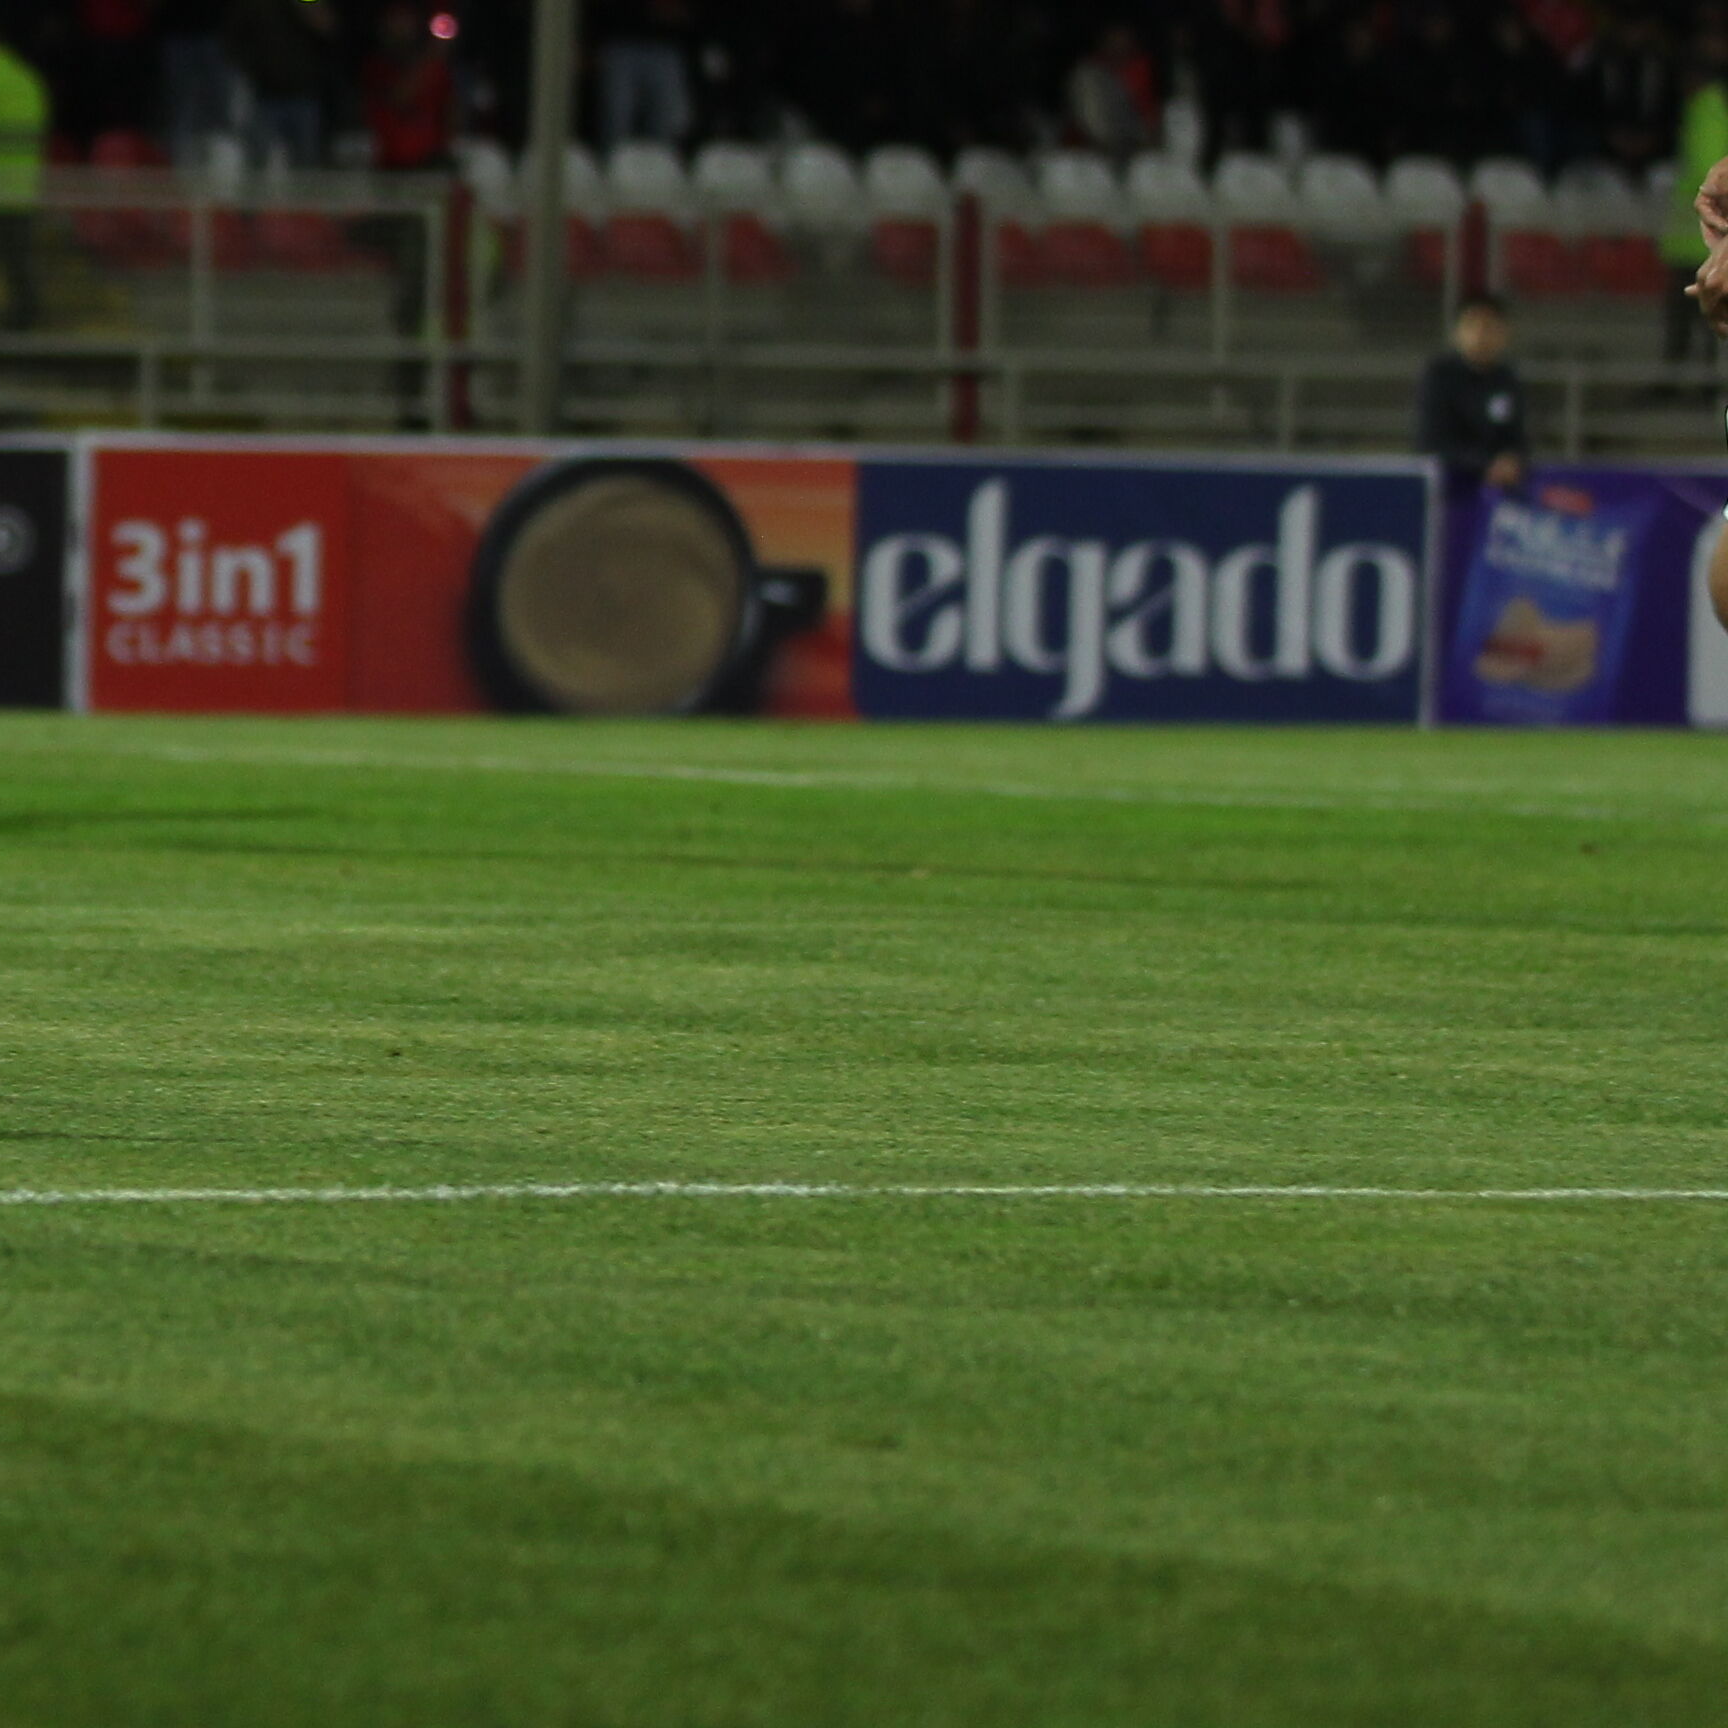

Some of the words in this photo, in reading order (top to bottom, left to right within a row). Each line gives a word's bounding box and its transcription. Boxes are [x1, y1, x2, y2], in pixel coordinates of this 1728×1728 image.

[107, 518, 322, 618] 3in1
[859, 476, 1418, 720] elgado
[106, 623, 319, 666] CLASSIC
